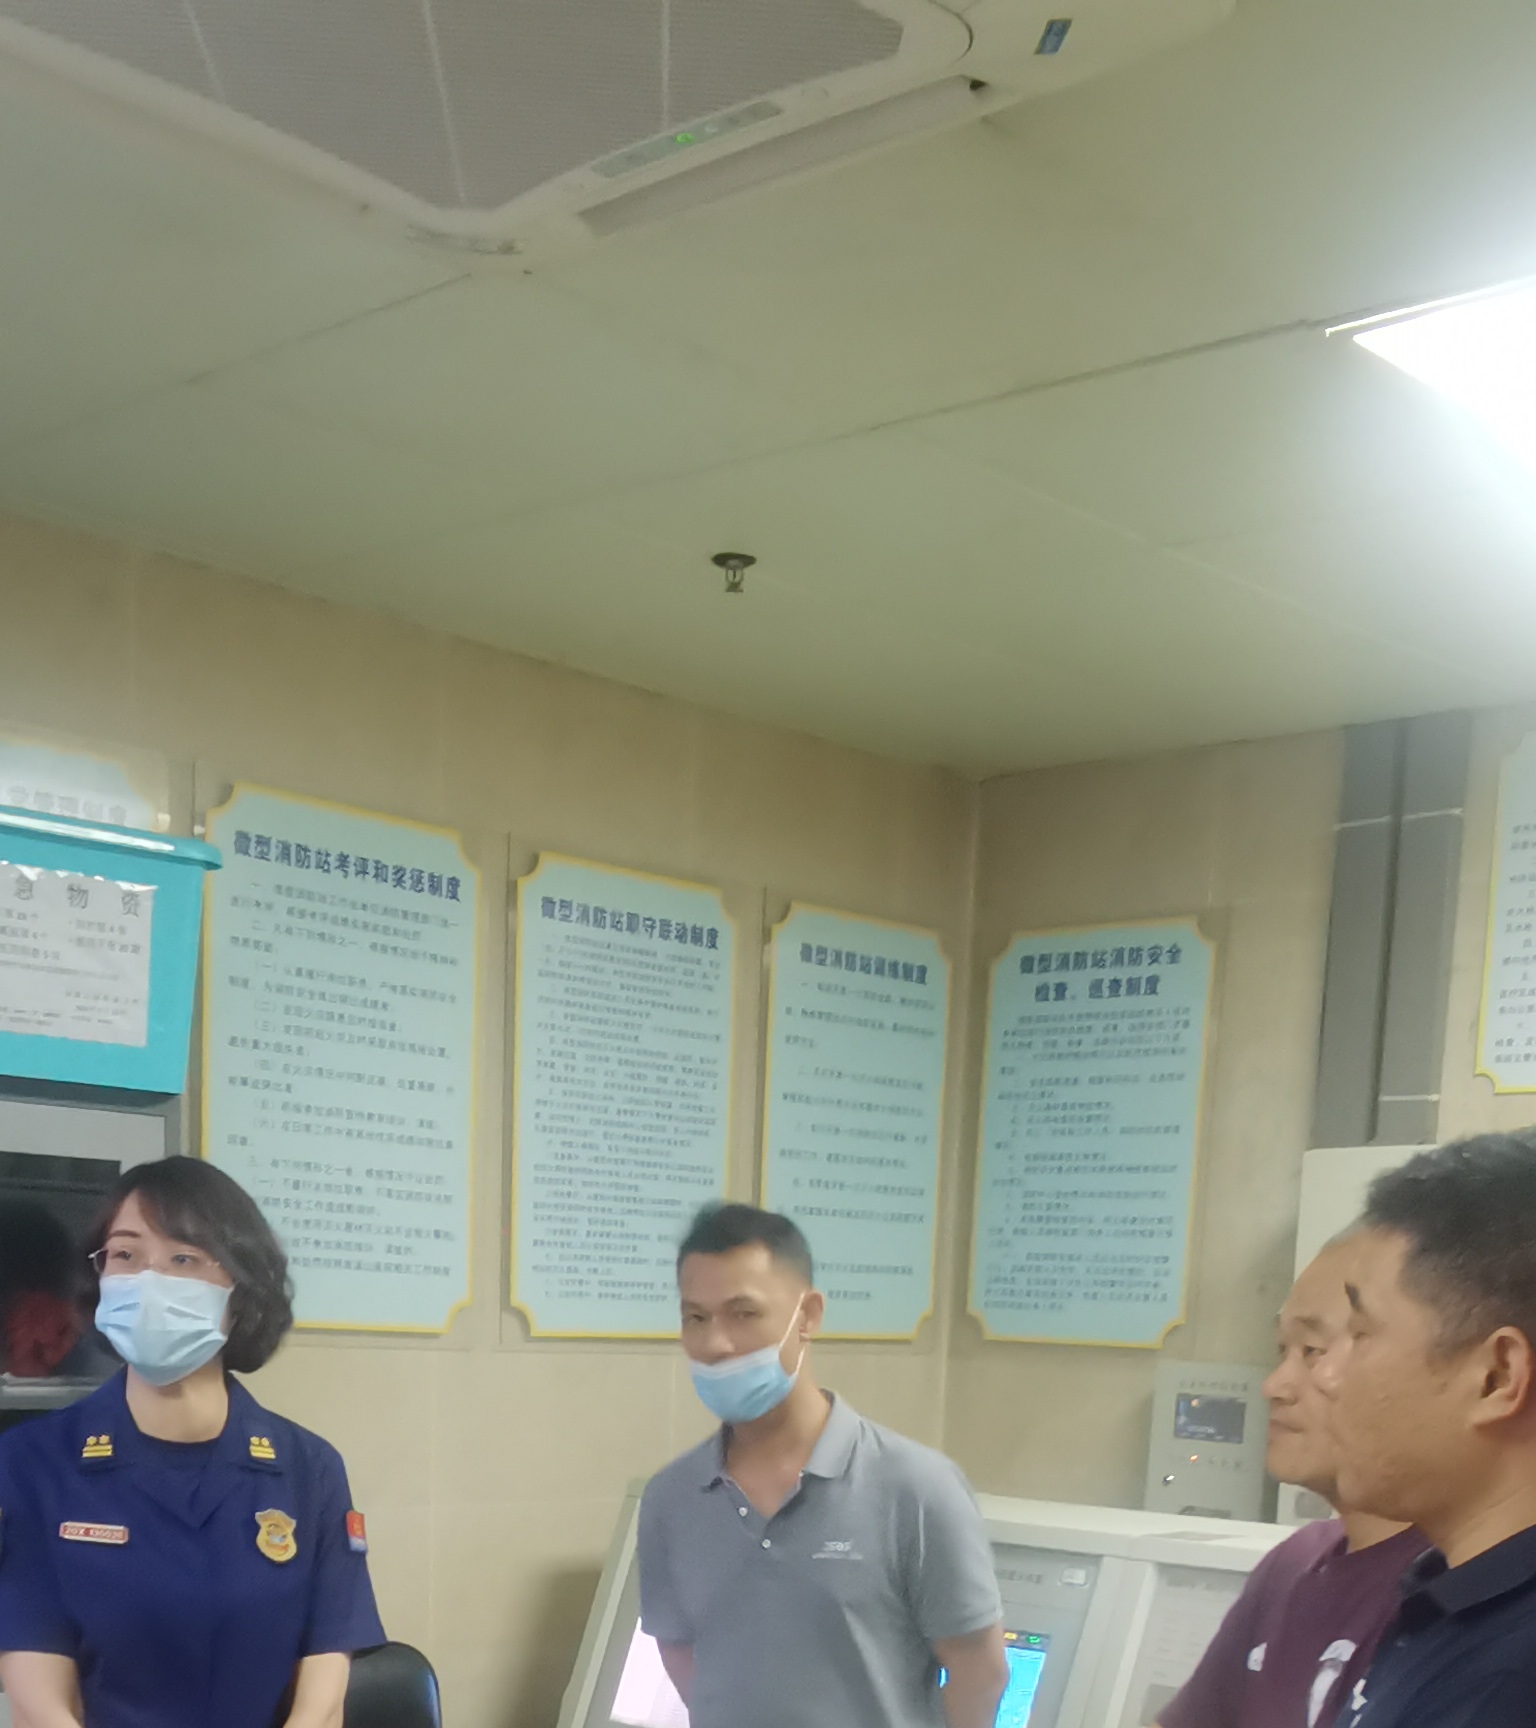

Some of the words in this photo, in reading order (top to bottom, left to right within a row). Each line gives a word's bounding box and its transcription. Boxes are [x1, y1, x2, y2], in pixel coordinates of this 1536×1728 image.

[233, 830, 462, 903] 微型消防站考评和奖惩制度
